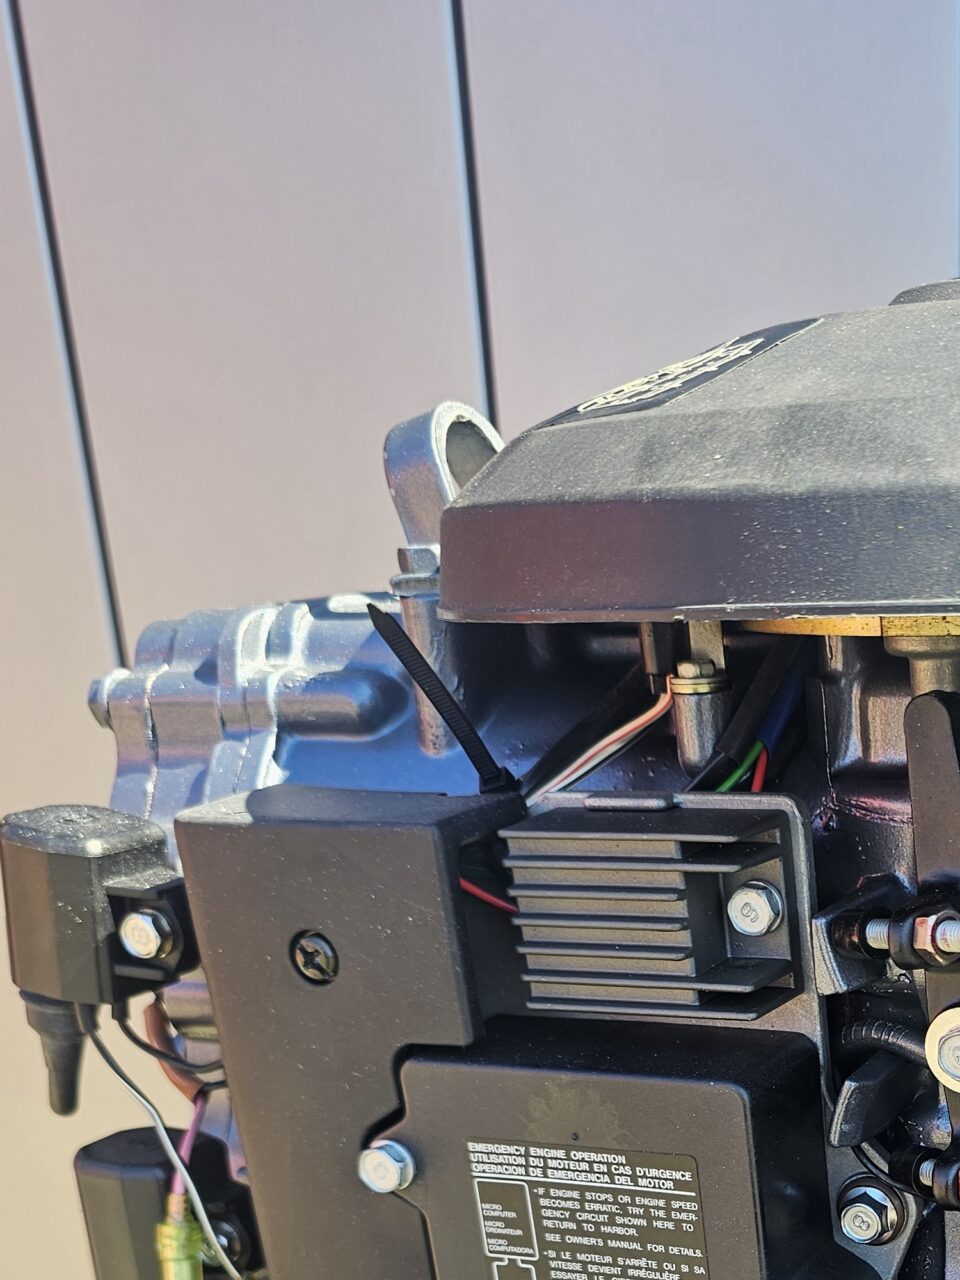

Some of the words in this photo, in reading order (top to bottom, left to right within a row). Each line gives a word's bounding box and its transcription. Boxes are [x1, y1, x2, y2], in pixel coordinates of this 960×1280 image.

[467, 1142, 526, 1155] EMERGENCY
[528, 1147, 567, 1159] ENGINE
[570, 1151, 626, 1164] OPERATION
[469, 1153, 526, 1166] UTILISATION
[529, 1157, 544, 1167] DU
[547, 1159, 590, 1171] MOTEUR
[593, 1163, 607, 1173] EN
[611, 1165, 632, 1175] CAS
[636, 1167, 693, 1181] D'URGENCE
[472, 1163, 526, 1176] OPERACION
[529, 1167, 544, 1177] DE
[547, 1169, 611, 1184] EMERGENCIA
[614, 1175, 634, 1186] DEL
[638, 1178, 674, 1190] MOTOR
[481, 1203, 503, 1211] MICRO
[537, 1187, 546, 1196] IF
[550, 1188, 581, 1199] ENGINE
[584, 1192, 614, 1202] STOPS
[617, 1195, 632, 1204] OR
[635, 1196, 667, 1208] ENGINE
[670, 1200, 699, 1211] SPEED
[540, 1198, 581, 1210] BECOMES
[627, 1206, 645, 1216] TRY
[649, 1208, 667, 1218] THE
[671, 1211, 699, 1221] EMER-
[484, 1220, 505, 1228] MICRO
[542, 1208, 570, 1219] GENCY
[576, 1212, 609, 1222] CIRCUIT
[615, 1216, 647, 1227] SHOWN
[653, 1220, 676, 1230] HERE
[681, 1223, 694, 1232] TO
[543, 1219, 577, 1230] RETURN
[581, 1223, 595, 1232] TO
[487, 1238, 508, 1246] MICRO
[545, 1233, 562, 1242] SEE
[607, 1239, 643, 1251] MANUAL
[647, 1243, 666, 1253] FOR
[547, 1250, 556, 1258] SI
[561, 1251, 572, 1260] LE
[576, 1253, 613, 1264] MOTEUR
[663, 1262, 676, 1271] OU
[681, 1264, 689, 1273] SI
[693, 1266, 706, 1275] SA
[549, 1260, 583, 1271] VITESSE
[587, 1264, 622, 1275] DEVIENT
